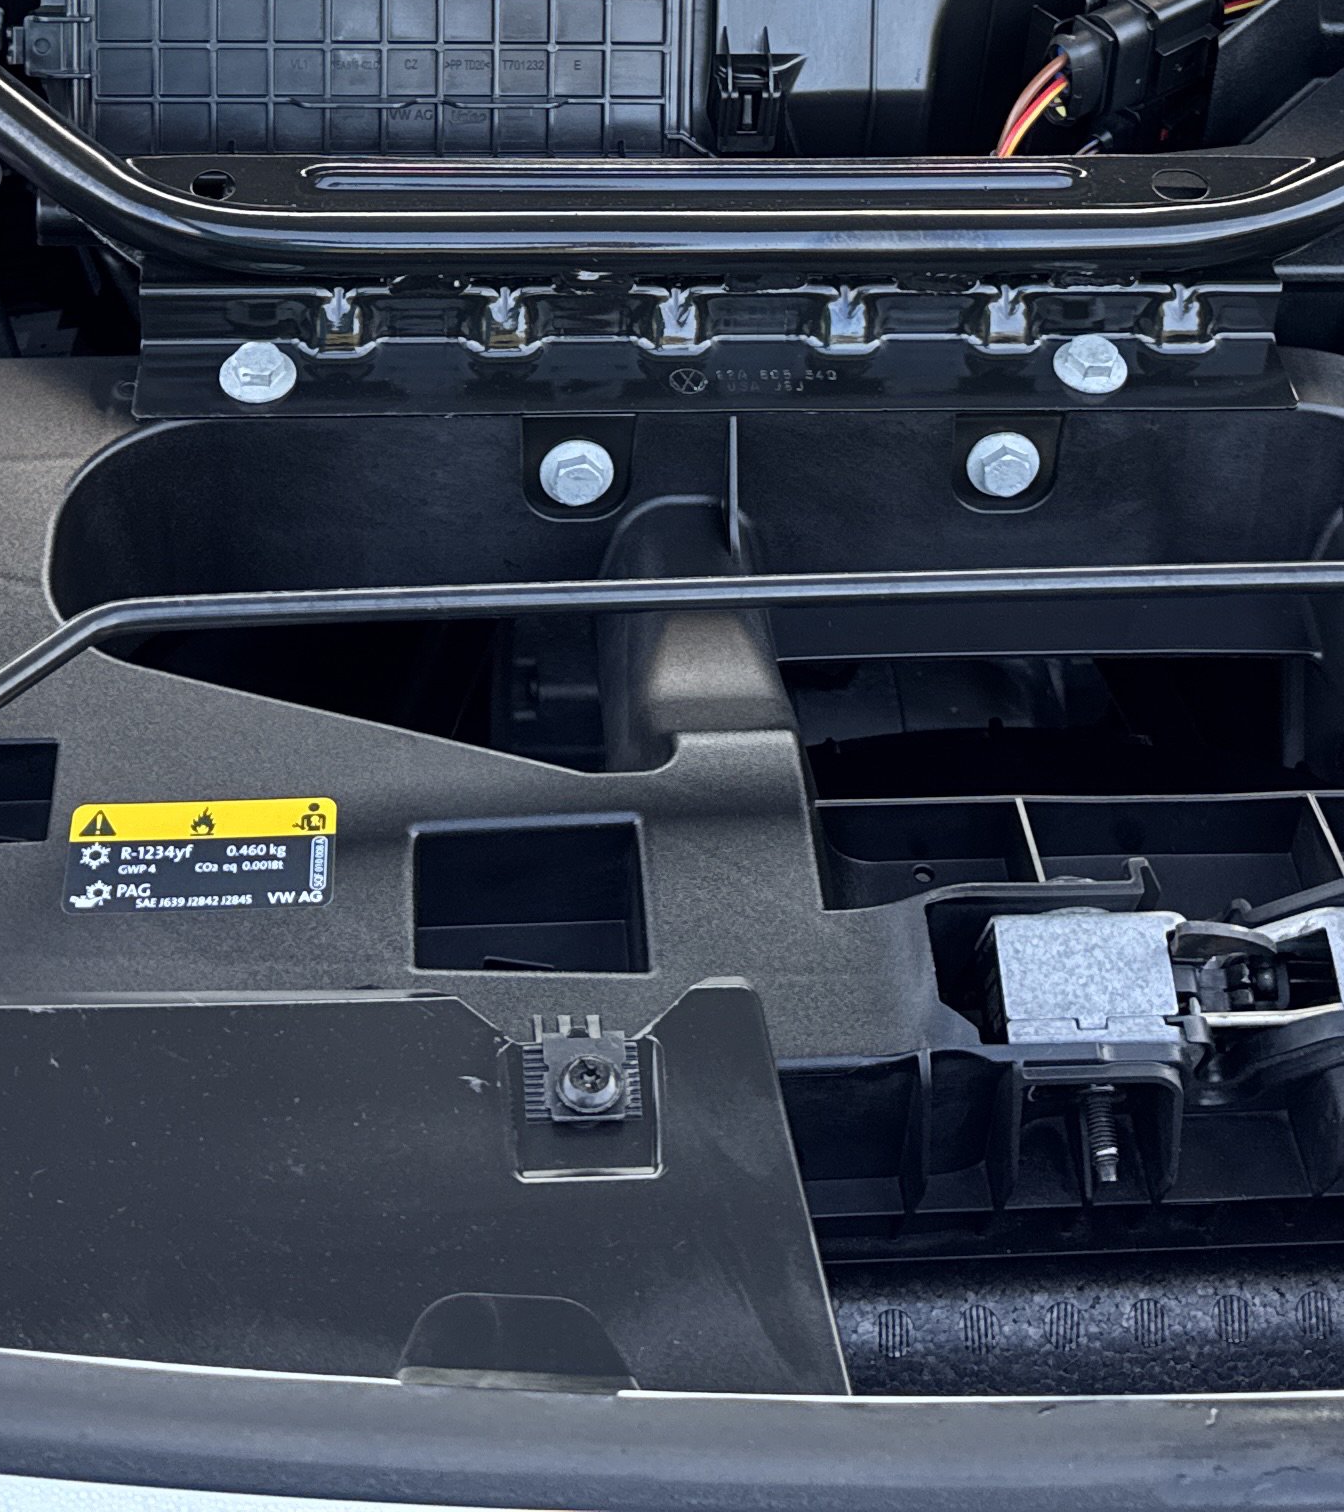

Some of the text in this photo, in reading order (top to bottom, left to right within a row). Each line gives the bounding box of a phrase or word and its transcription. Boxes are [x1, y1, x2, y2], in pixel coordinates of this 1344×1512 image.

[389, 109, 433, 121] VW AG
[727, 381, 760, 392] USA
[119, 843, 287, 862] R-1234yf 0.460 kg
[118, 864, 146, 875] GWP
[147, 864, 157, 874] 4
[222, 862, 238, 874] eq
[116, 884, 324, 905] PAG VW AG
[135, 894, 253, 909] SAE J639 J2842 J2845
